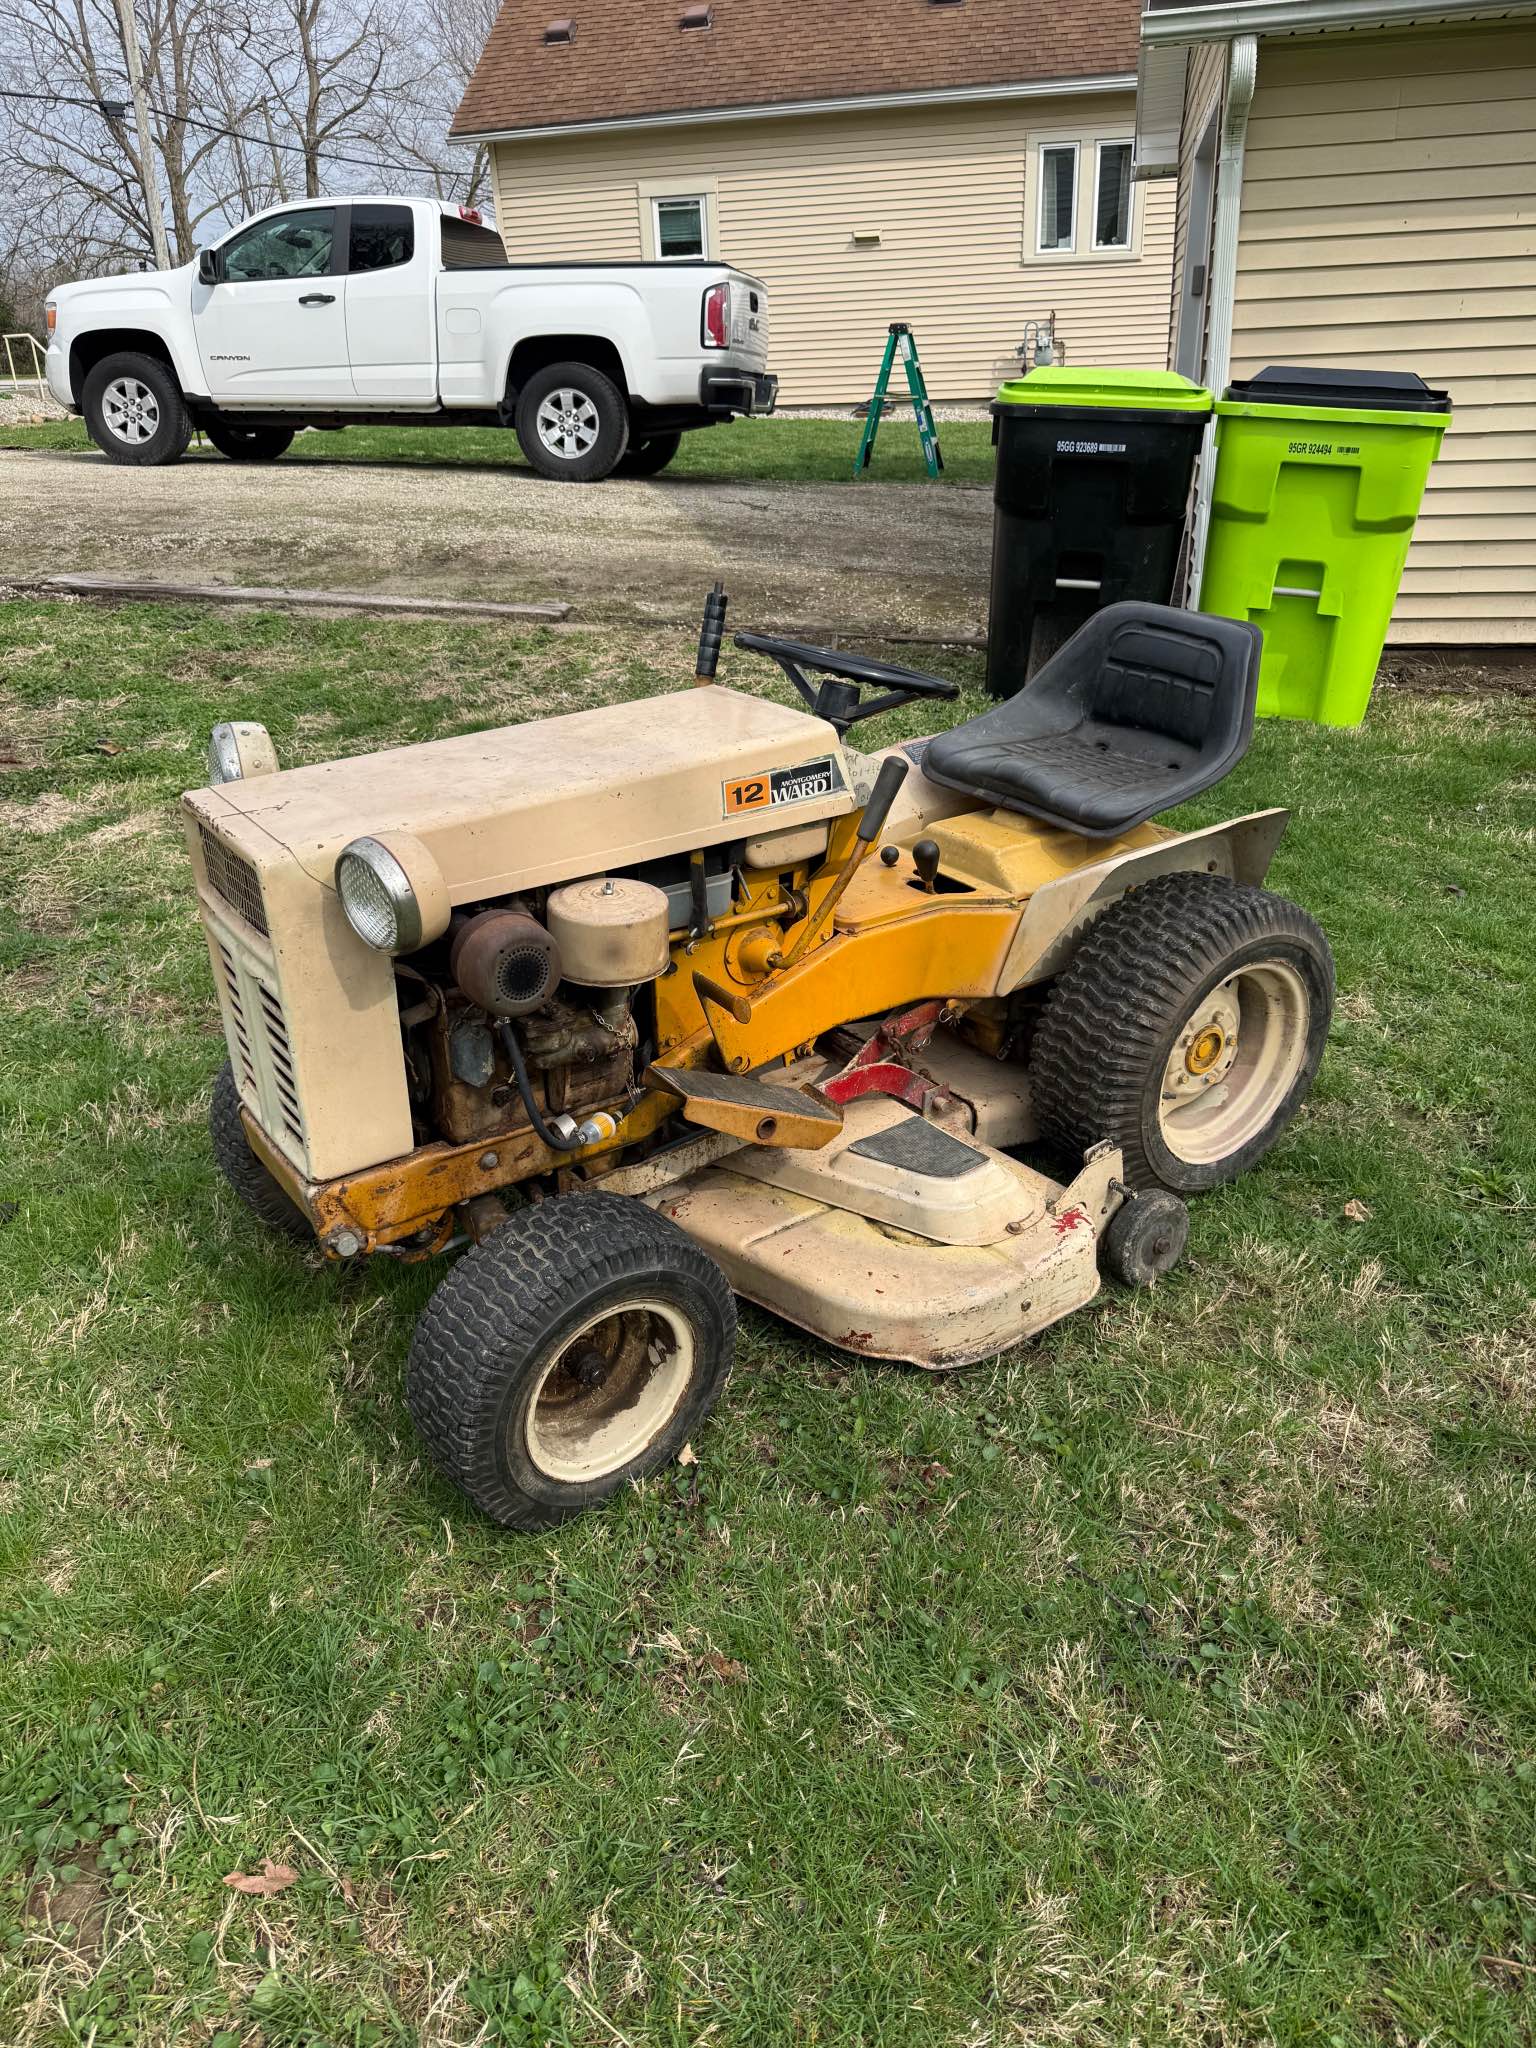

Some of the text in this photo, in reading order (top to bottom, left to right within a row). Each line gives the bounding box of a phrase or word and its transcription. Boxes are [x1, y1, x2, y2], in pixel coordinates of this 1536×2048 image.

[1056, 440, 1098, 453] 95GG 923689
[1288, 442, 1332, 455] 95GR 924494
[780, 770, 832, 787] MONTGOMERY
[732, 783, 764, 806] 12
[771, 779, 827, 805] WARD
